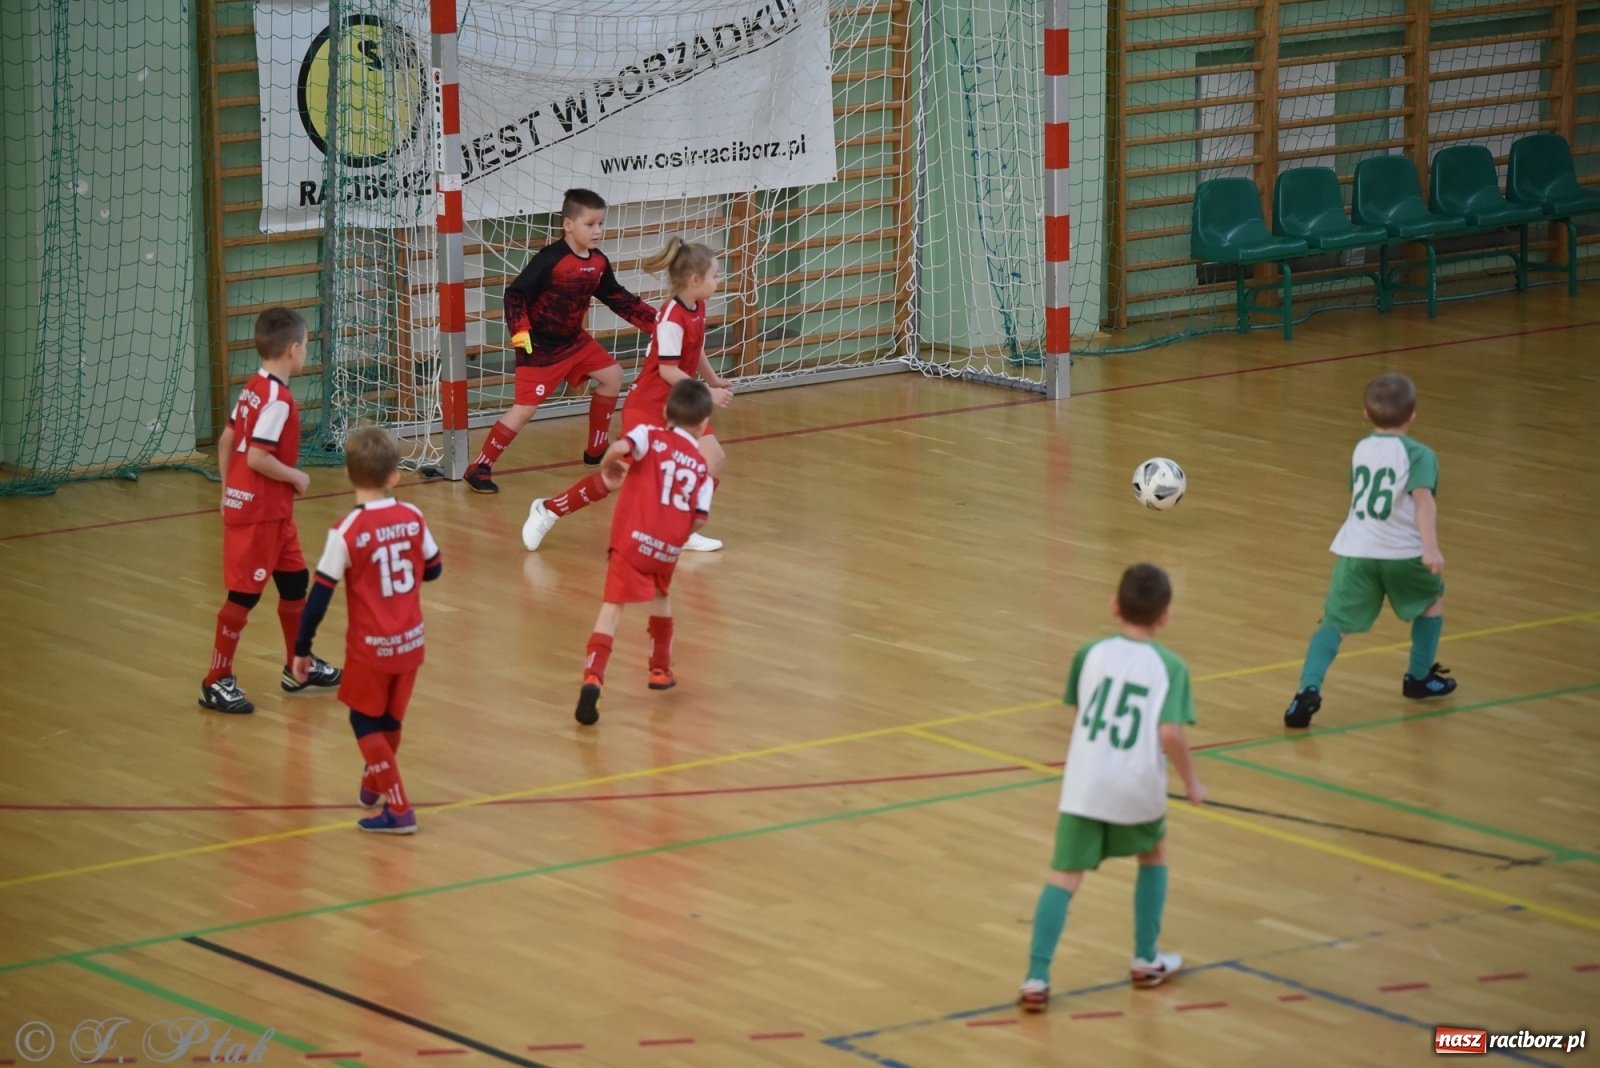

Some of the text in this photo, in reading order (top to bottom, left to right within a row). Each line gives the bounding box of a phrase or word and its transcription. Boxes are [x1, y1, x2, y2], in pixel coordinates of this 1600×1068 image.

[550, 90, 589, 133] W
[600, 134, 806, 174] www.osir-raciborz.pl
[659, 459, 698, 512] 13
[1353, 465, 1396, 521] 26
[371, 540, 416, 598] 15
[1082, 676, 1149, 750] 45
